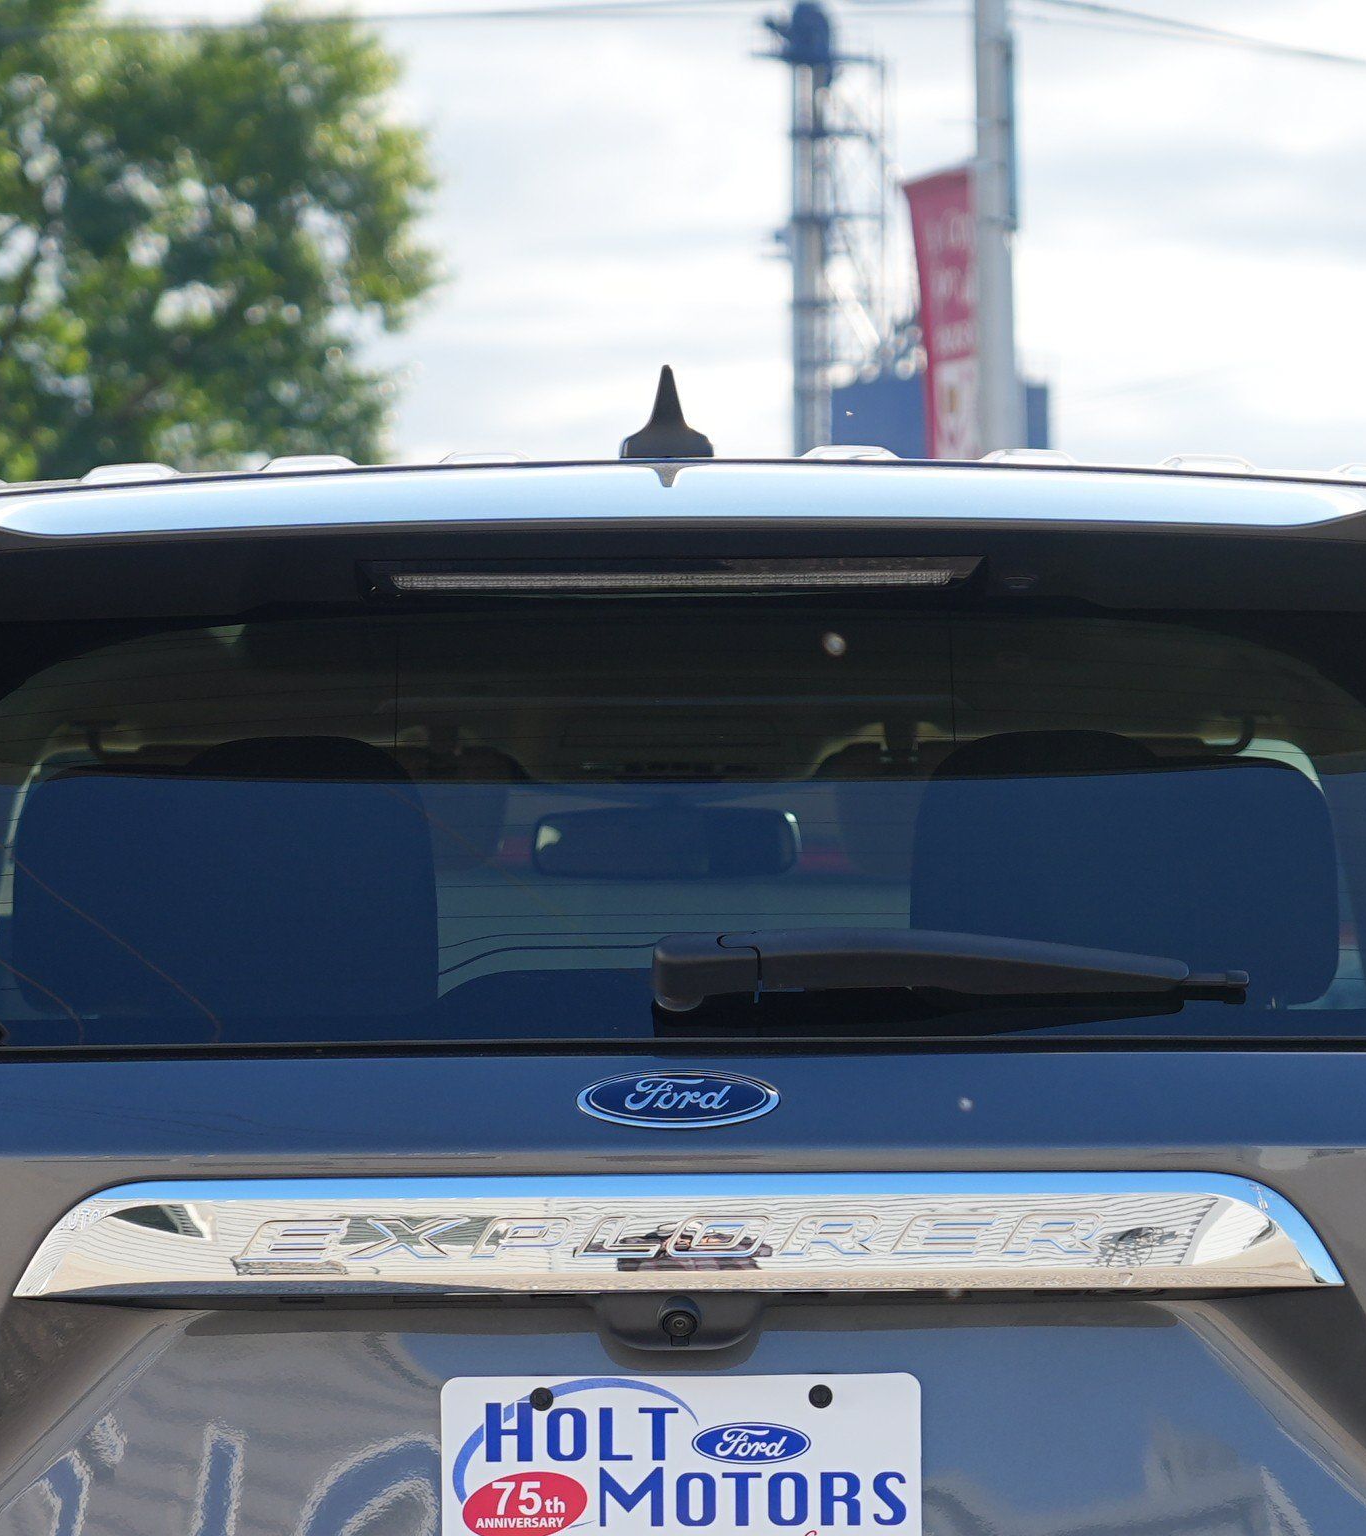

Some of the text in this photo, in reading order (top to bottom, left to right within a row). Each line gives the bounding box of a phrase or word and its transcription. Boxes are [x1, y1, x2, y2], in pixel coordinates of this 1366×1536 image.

[624, 1078, 733, 1111] Ford
[234, 1215, 1104, 1262] EXPLORER
[485, 1401, 679, 1463] HOLT
[715, 1426, 788, 1458] Ford
[487, 1479, 567, 1516] 75th
[598, 1463, 908, 1528] MOTORS
[475, 1516, 567, 1529] ANNIVERSARY
